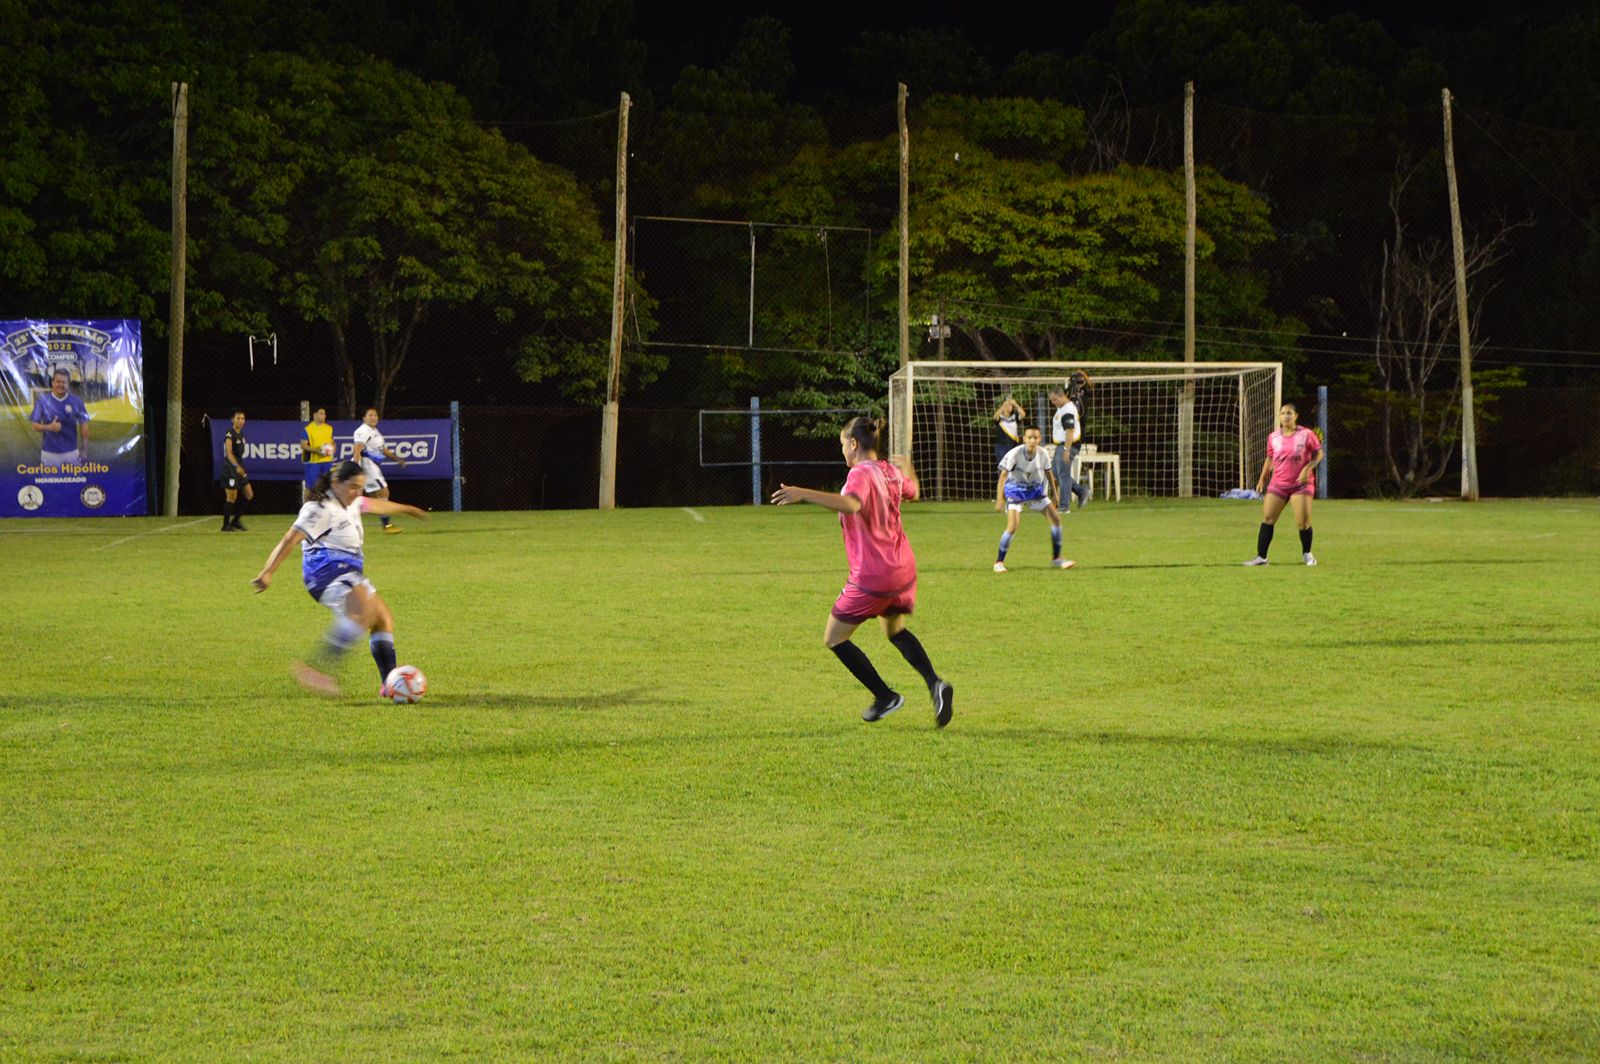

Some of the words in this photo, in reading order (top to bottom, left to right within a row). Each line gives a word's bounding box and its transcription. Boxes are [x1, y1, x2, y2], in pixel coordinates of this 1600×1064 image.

[224, 443, 303, 460] UNESP
[17, 463, 59, 475] Carlos
[61, 462, 109, 476] Hipólito
